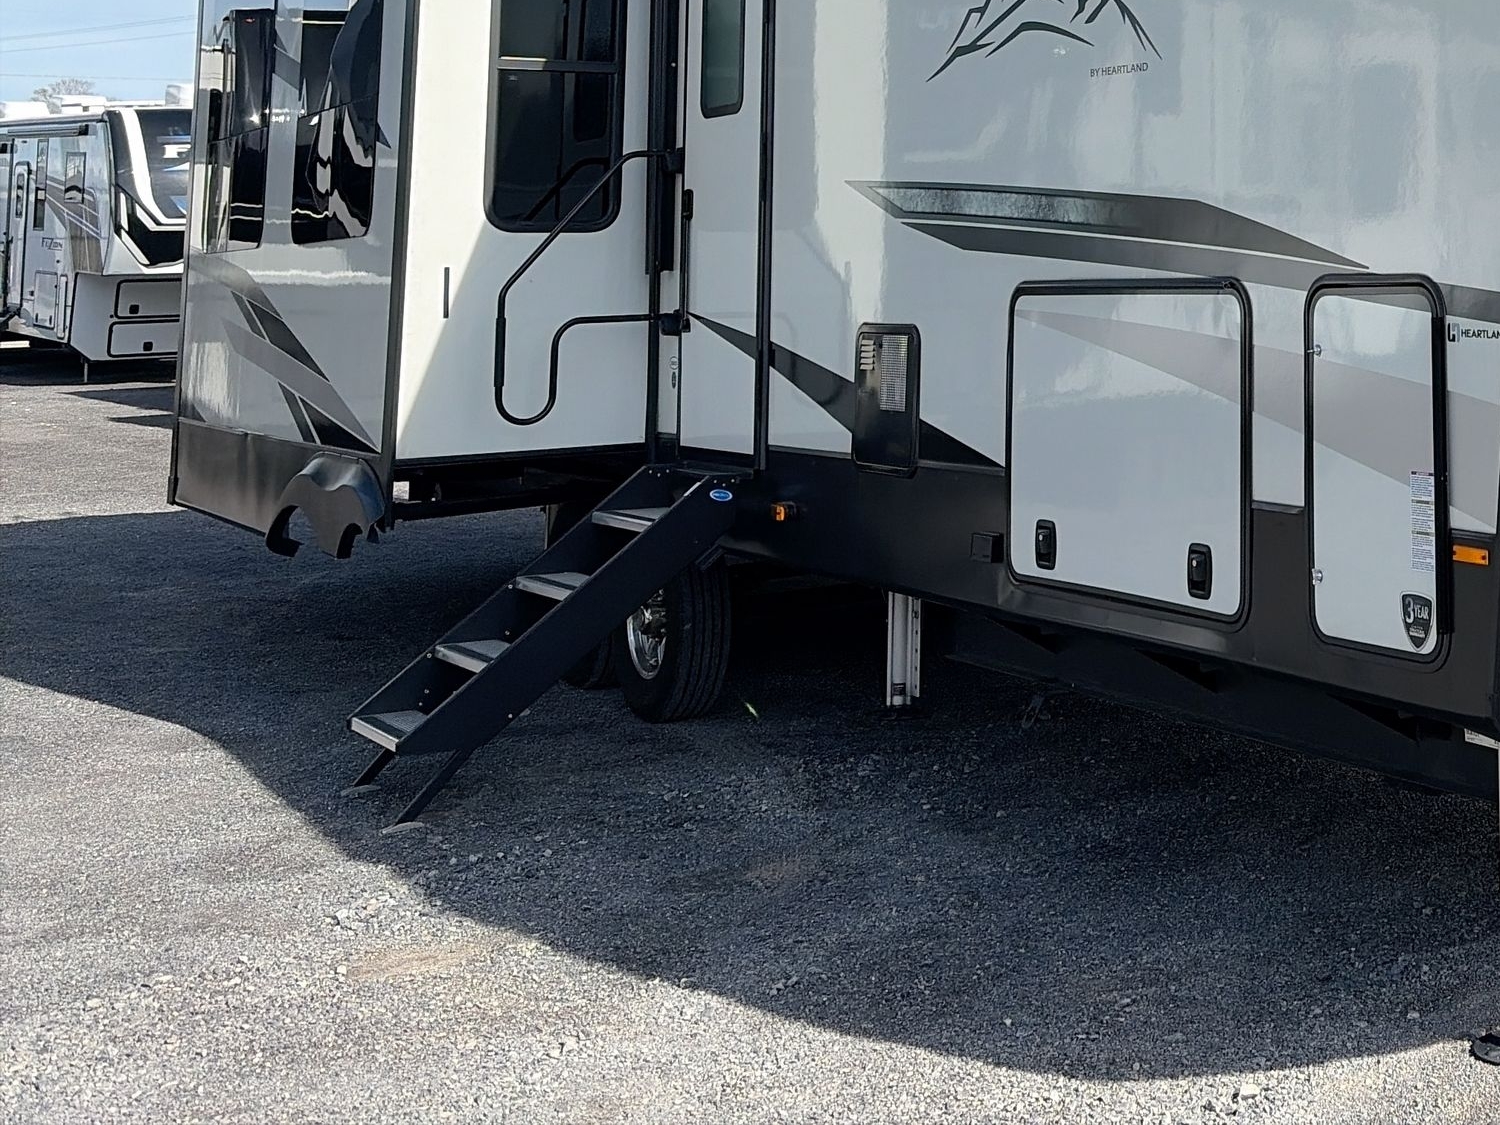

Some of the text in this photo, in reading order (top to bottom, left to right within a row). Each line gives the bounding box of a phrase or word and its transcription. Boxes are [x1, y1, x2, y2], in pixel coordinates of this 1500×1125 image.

[1089, 62, 1149, 78] BY HEARTLAND
[1405, 597, 1415, 624] 3
